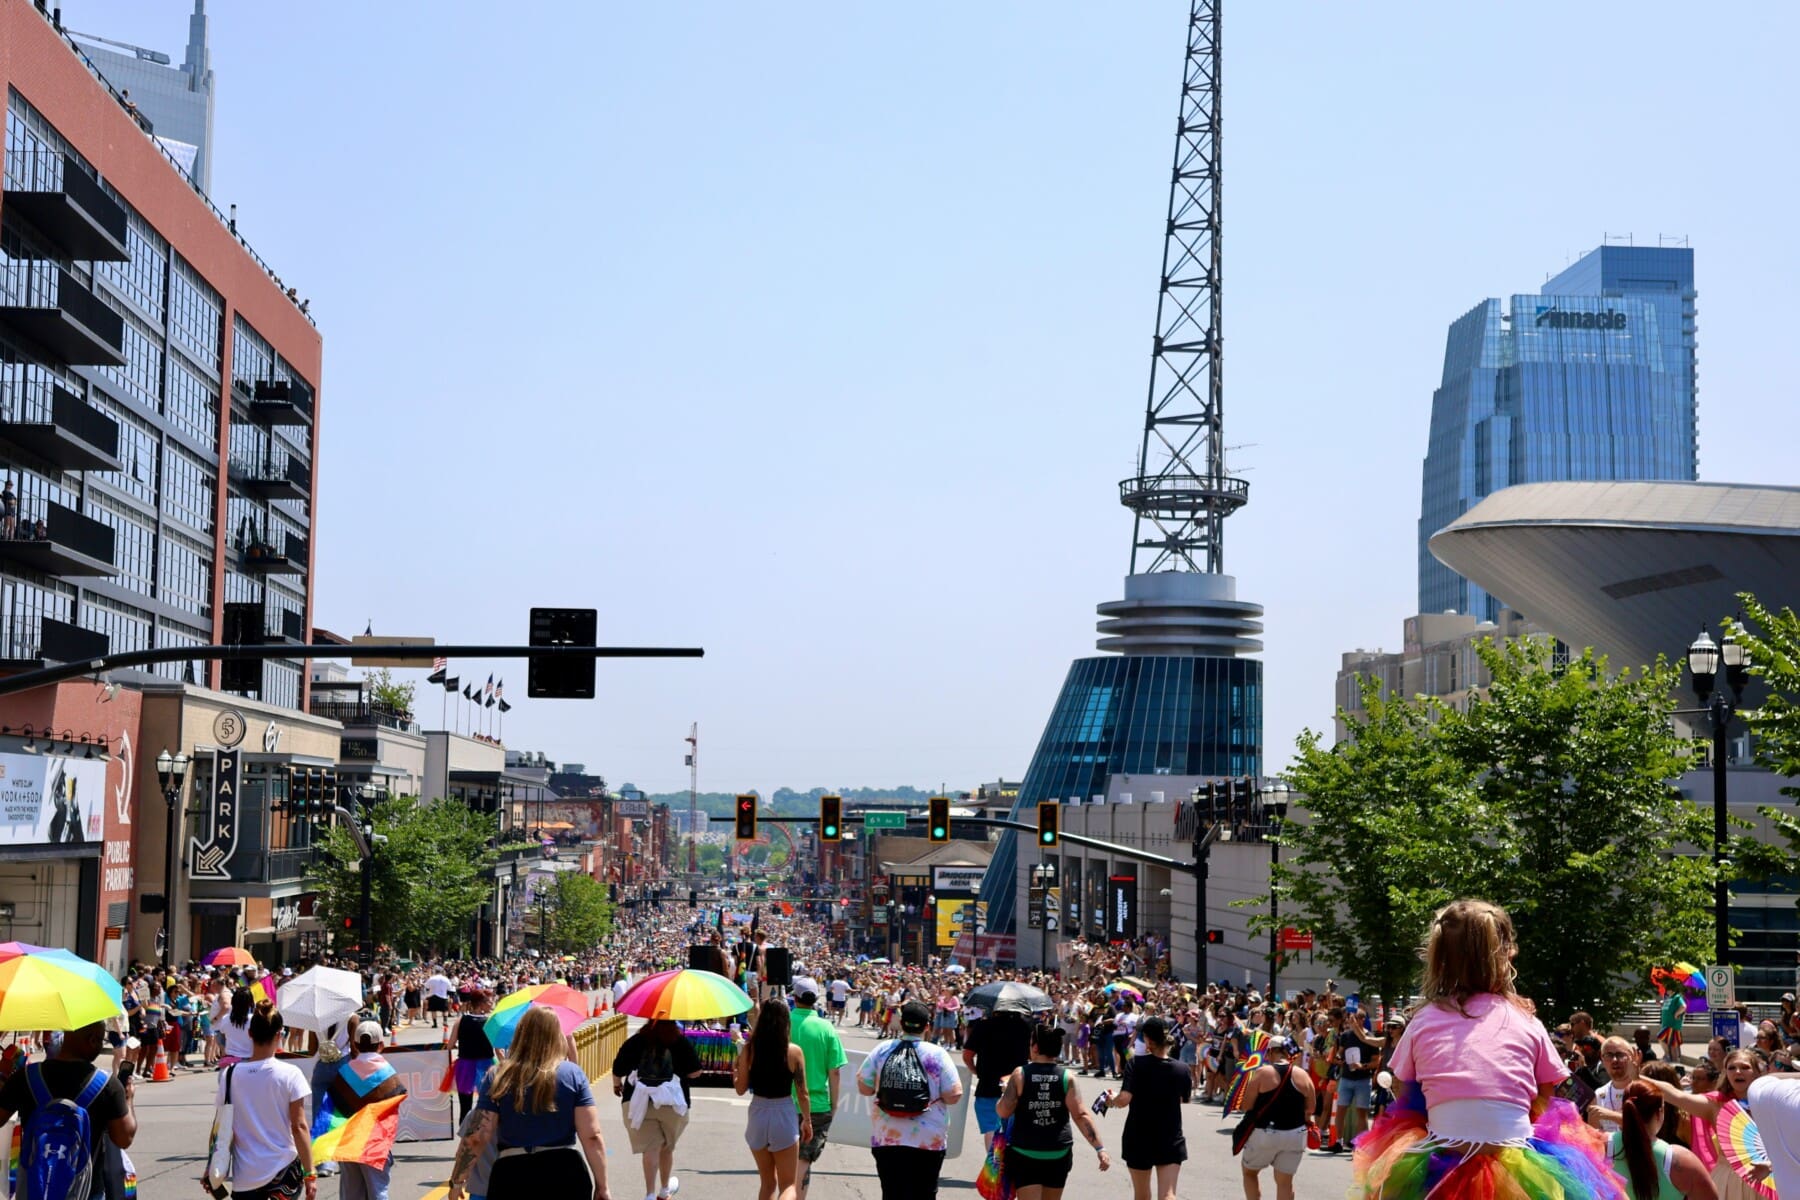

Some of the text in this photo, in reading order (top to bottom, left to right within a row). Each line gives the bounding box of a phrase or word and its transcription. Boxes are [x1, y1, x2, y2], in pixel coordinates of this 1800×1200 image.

[1536, 305, 1627, 330] Pinnacle
[218, 758, 233, 839] PARK
[106, 841, 130, 864] PUBLIC
[105, 867, 134, 891] PARKING
